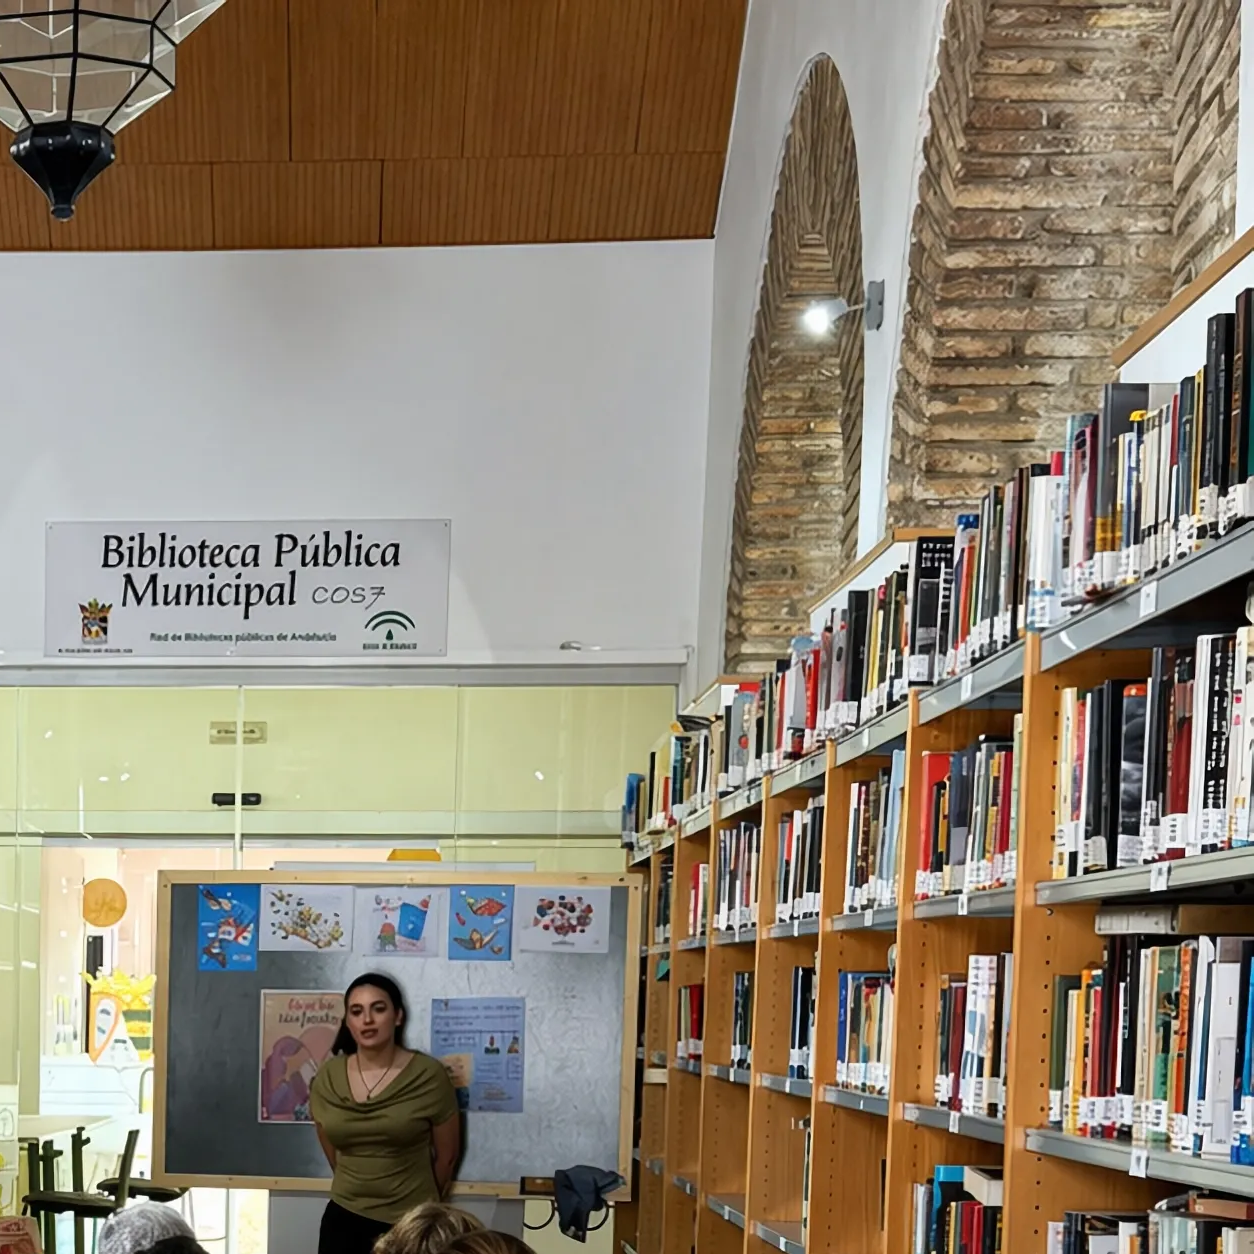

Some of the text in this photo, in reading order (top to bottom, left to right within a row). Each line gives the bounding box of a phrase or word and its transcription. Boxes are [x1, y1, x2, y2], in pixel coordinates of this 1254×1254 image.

[101, 530, 401, 569] Biblioteca Pública
[121, 570, 298, 620] Municipal
